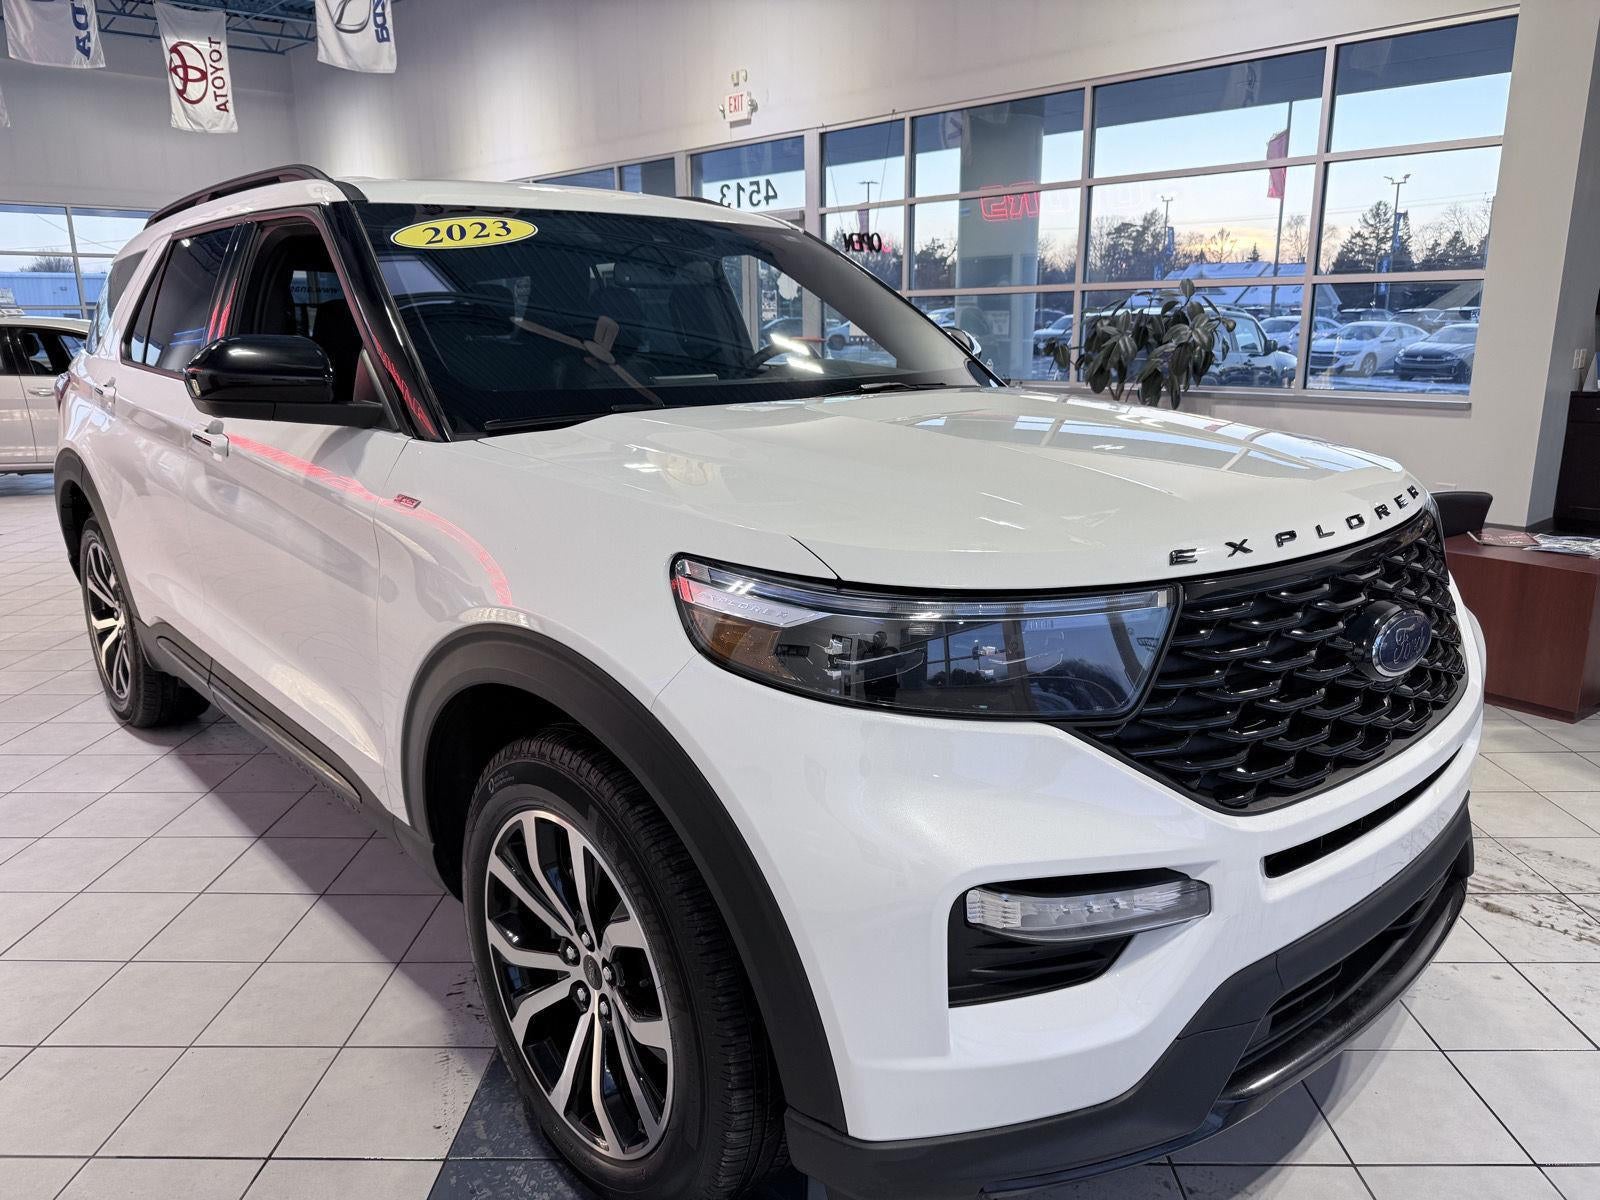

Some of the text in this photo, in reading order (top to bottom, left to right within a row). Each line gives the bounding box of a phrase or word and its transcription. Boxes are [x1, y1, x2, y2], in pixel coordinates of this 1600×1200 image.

[728, 93, 744, 113] EXIT
[421, 220, 512, 245] 2023
[1168, 484, 1420, 566] EXPLORER
